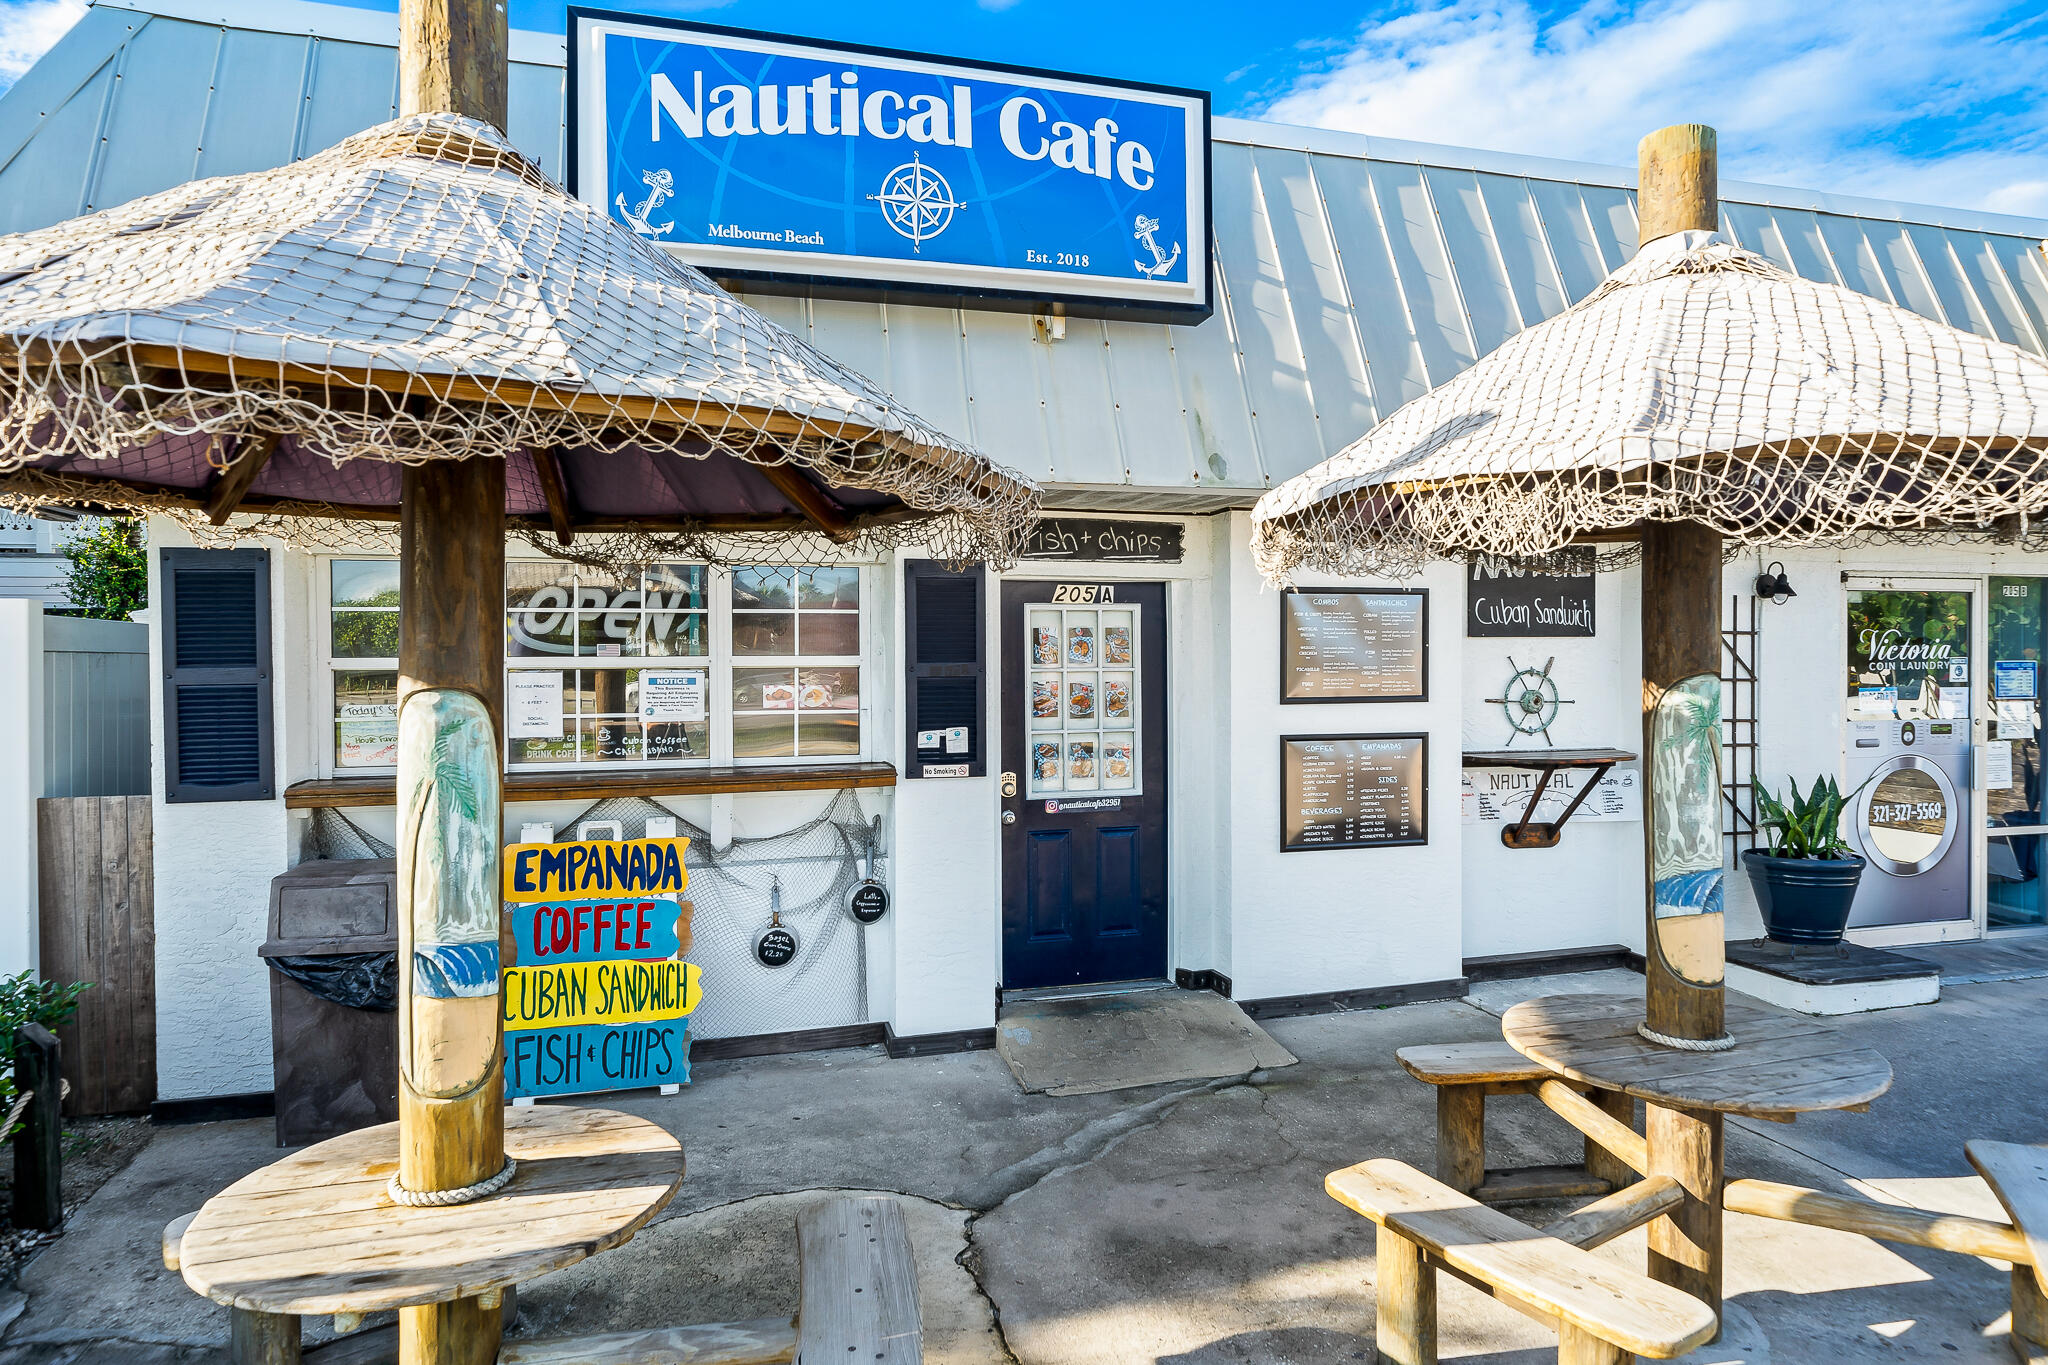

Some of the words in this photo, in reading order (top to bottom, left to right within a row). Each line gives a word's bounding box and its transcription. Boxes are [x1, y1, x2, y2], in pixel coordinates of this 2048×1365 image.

[650, 70, 973, 149] Nautical
[999, 96, 1155, 192] Cafe
[708, 223, 783, 242] Melbourne
[784, 229, 825, 246] Beach
[1026, 249, 1053, 264] Est.
[1056, 252, 1090, 268] 2018
[1098, 526, 1163, 554] chips
[1053, 585, 1096, 602] 205
[1101, 586, 1113, 603] A
[523, 586, 684, 640] OPEN
[1475, 597, 1530, 628] Cuban
[1534, 595, 1594, 634] Sandwich
[1860, 628, 1951, 661] Victoria
[1869, 661, 1896, 671] COIN
[1900, 660, 1951, 671] LAUNDRY
[526, 749, 553, 758] DRINK
[556, 749, 588, 758] COFFE
[1305, 744, 1335, 752] COFFEE
[933, 767, 957, 775] Smoking
[1490, 773, 1573, 789] NAUTIAL
[1300, 807, 1343, 815] BEVERAGES
[1872, 801, 1942, 823] 321-327-5569
[513, 843, 683, 893] EMPANADA
[533, 902, 656, 957] COFFEE
[503, 966, 588, 1022] CUBAN
[595, 962, 688, 1015] SANDWICH
[514, 1032, 583, 1088] FISH
[587, 1044, 597, 1062] &
[601, 1028, 675, 1080] CHIPS
